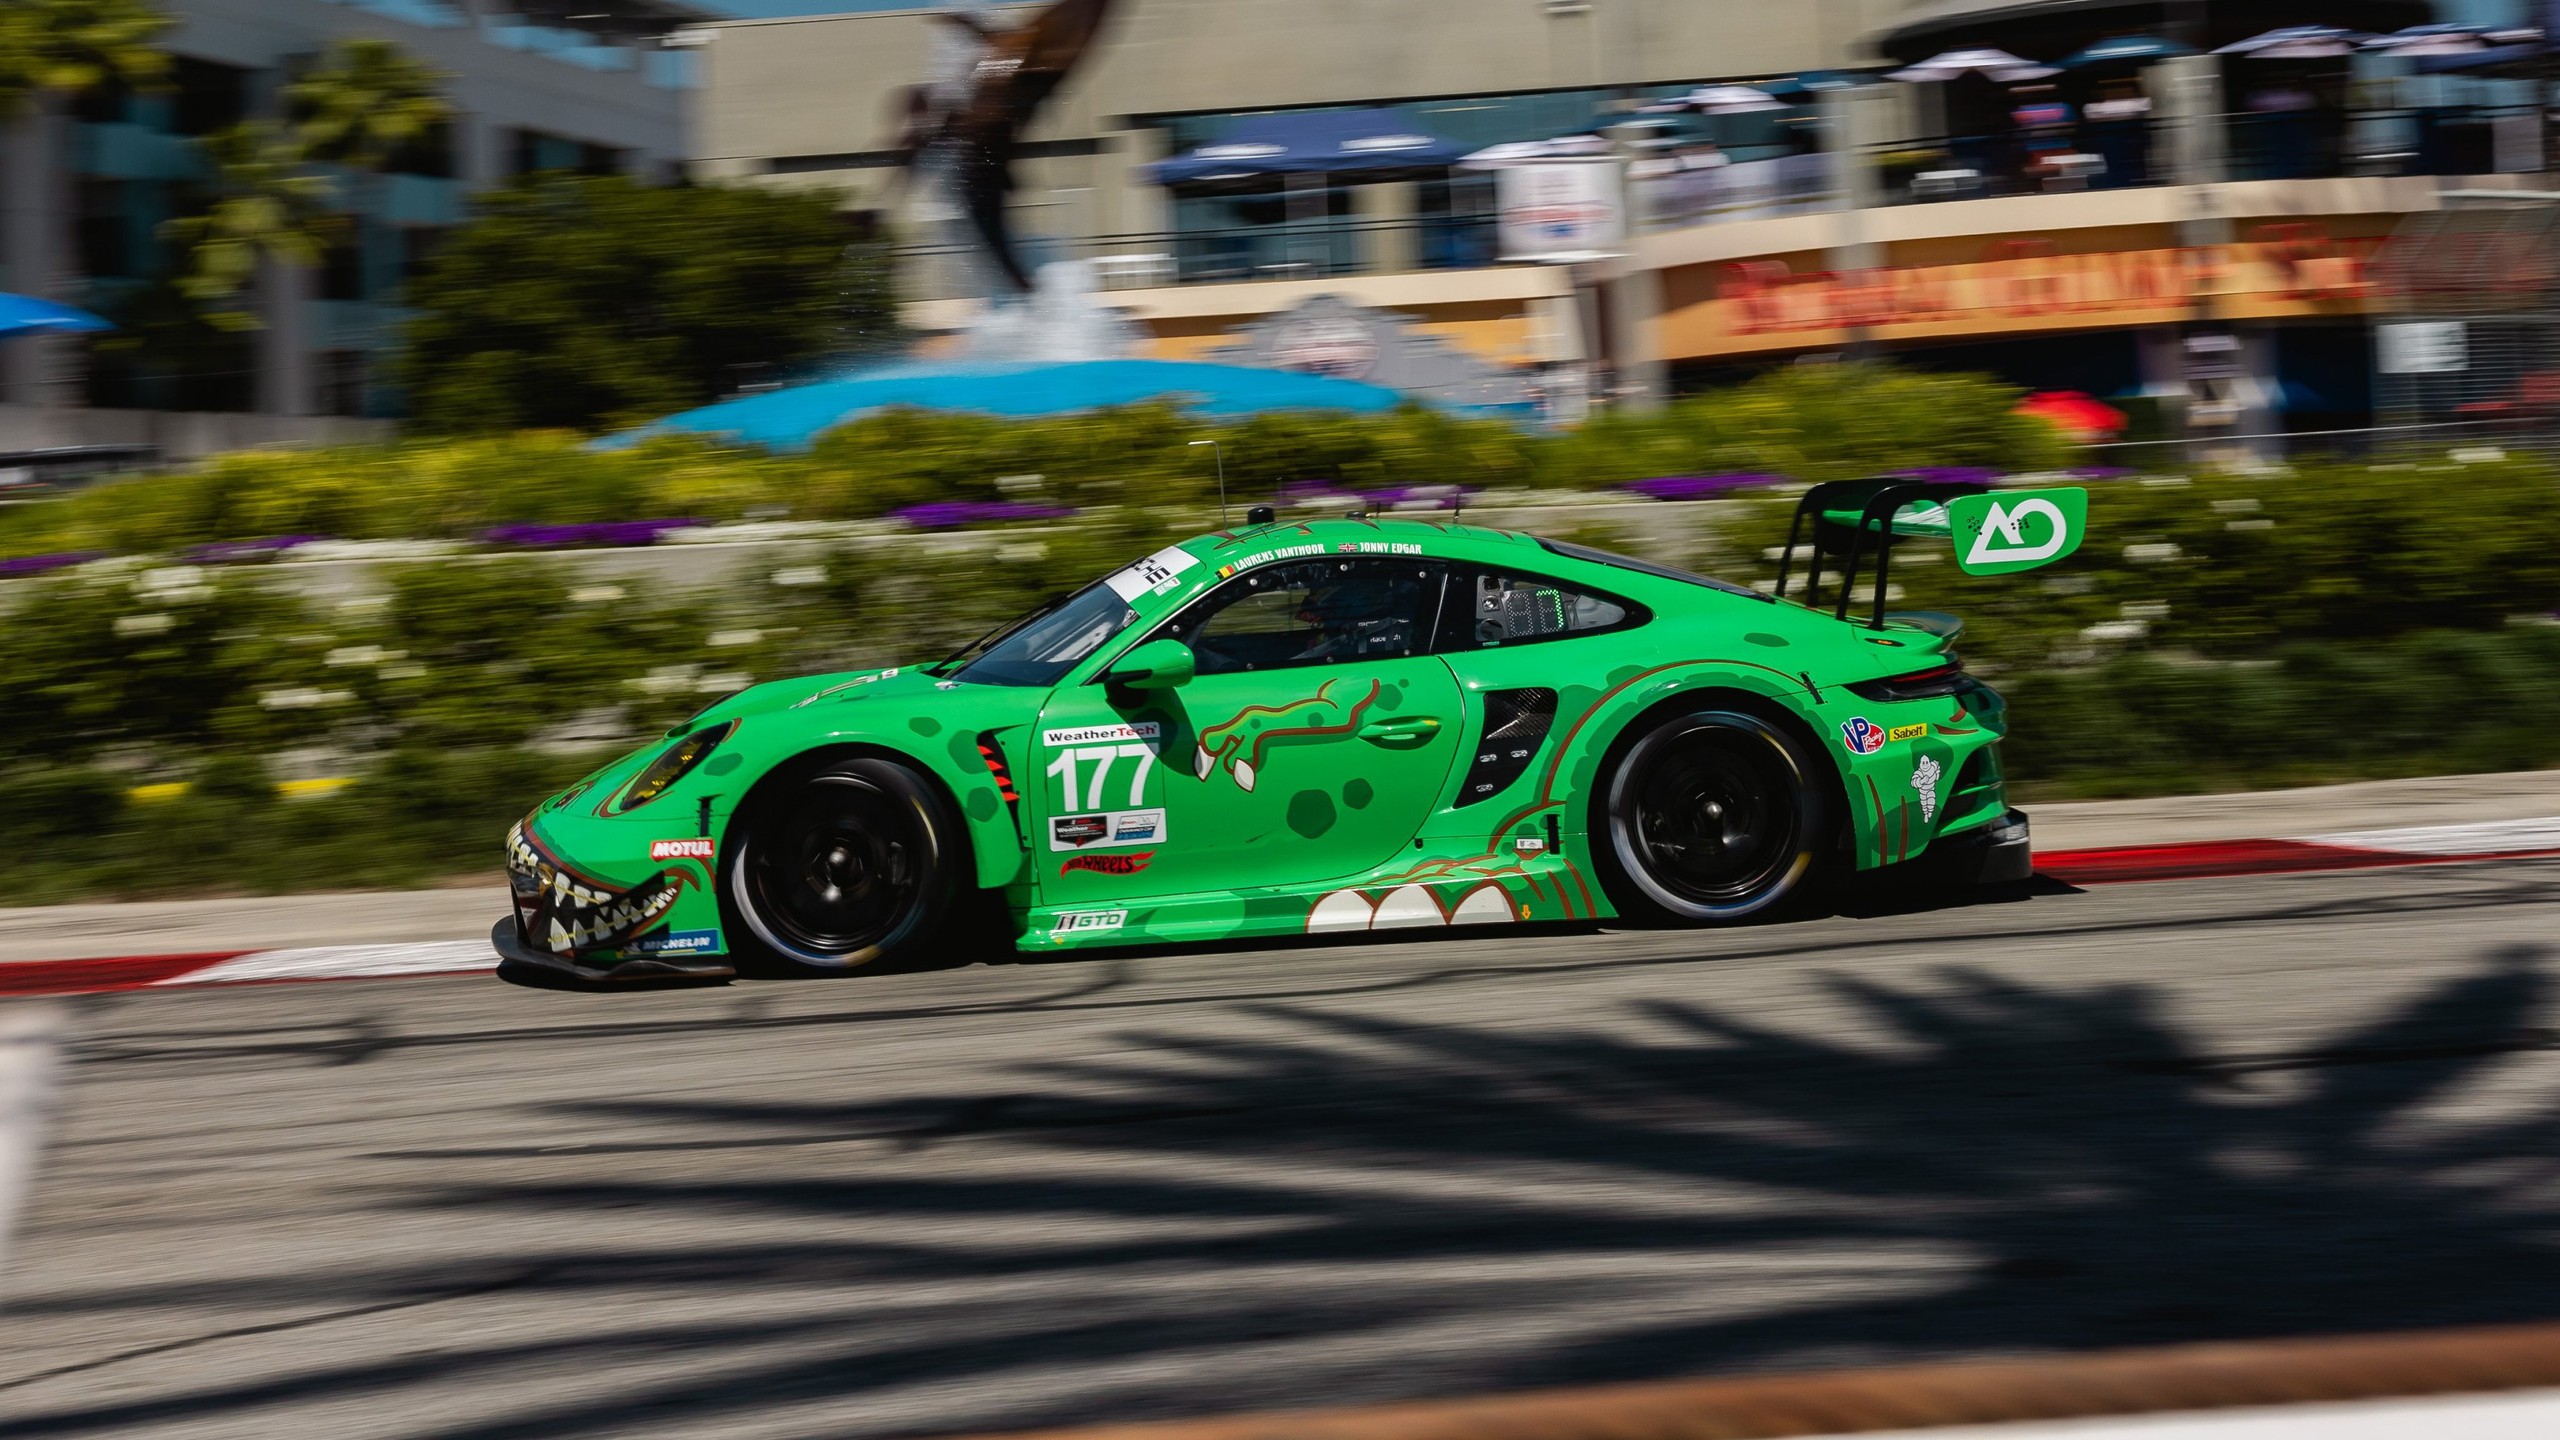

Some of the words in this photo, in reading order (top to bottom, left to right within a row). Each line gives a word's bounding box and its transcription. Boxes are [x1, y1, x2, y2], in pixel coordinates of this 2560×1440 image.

[1359, 542, 1389, 553] JONNY
[1391, 543, 1422, 554] EDGAR
[1234, 550, 1275, 571] LAURENS
[1275, 543, 1325, 559] VANTHOOR
[1048, 725, 1157, 742] WeatherTech
[1841, 717, 1870, 753] VP
[1893, 726, 1923, 740] Sabelt
[1047, 742, 1160, 812] 177
[652, 841, 713, 857] MOTUL
[1077, 914, 1120, 927] GTD
